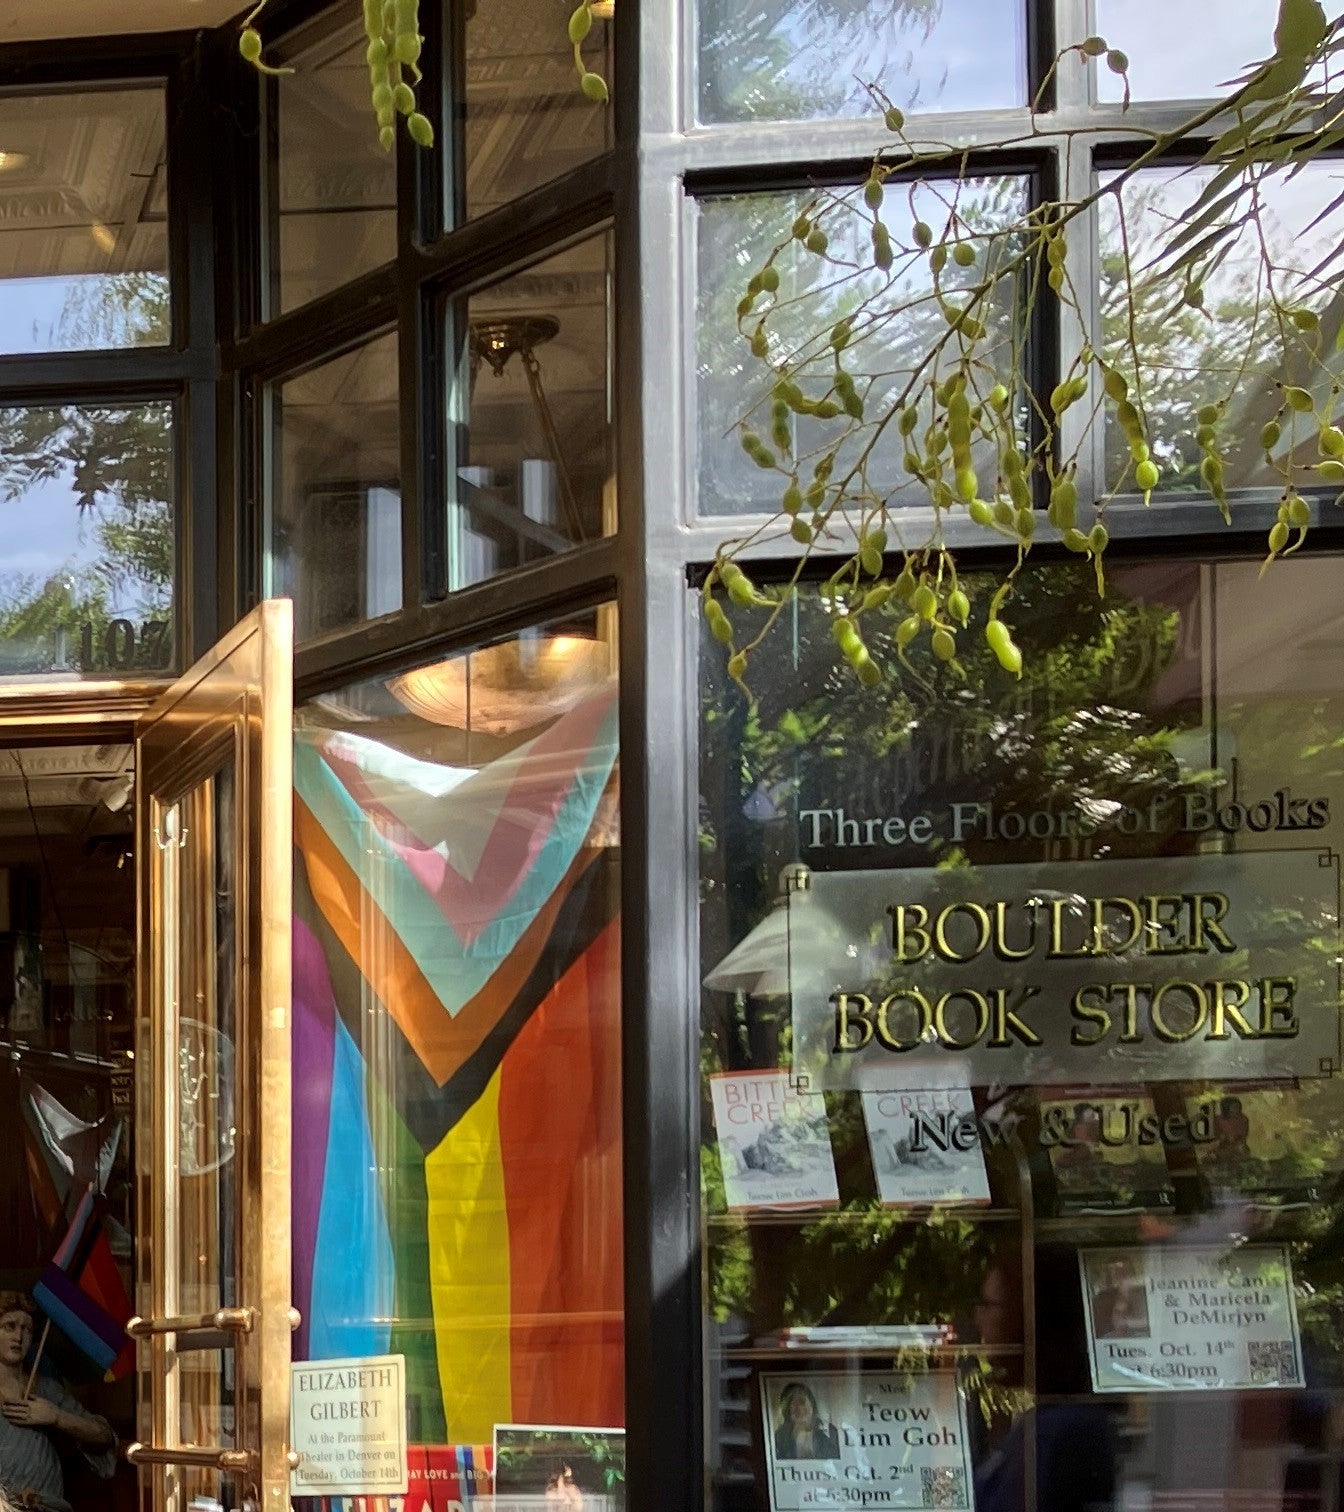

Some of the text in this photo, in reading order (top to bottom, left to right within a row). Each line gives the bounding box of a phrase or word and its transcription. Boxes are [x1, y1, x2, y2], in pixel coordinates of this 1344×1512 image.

[800, 808, 933, 849] Three
[1117, 795, 1160, 834] of
[1184, 787, 1331, 834] Books
[887, 891, 1236, 965] BOULDER
[829, 975, 1301, 1055] BOOK STORE
[908, 1105, 1217, 1152] New & Used
[1188, 1292, 1271, 1308] Maricela
[1159, 1341, 1197, 1357] Oct.
[1206, 1339, 1236, 1356] 14th
[299, 1368, 392, 1392] ELIZABETH
[310, 1400, 382, 1421] GILBERT
[863, 1402, 931, 1422] Teow
[843, 1426, 957, 1447] Lim Goh
[348, 1449, 381, 1461] Denver
[340, 1468, 376, 1480] October
[424, 1469, 449, 1480] LOVE
